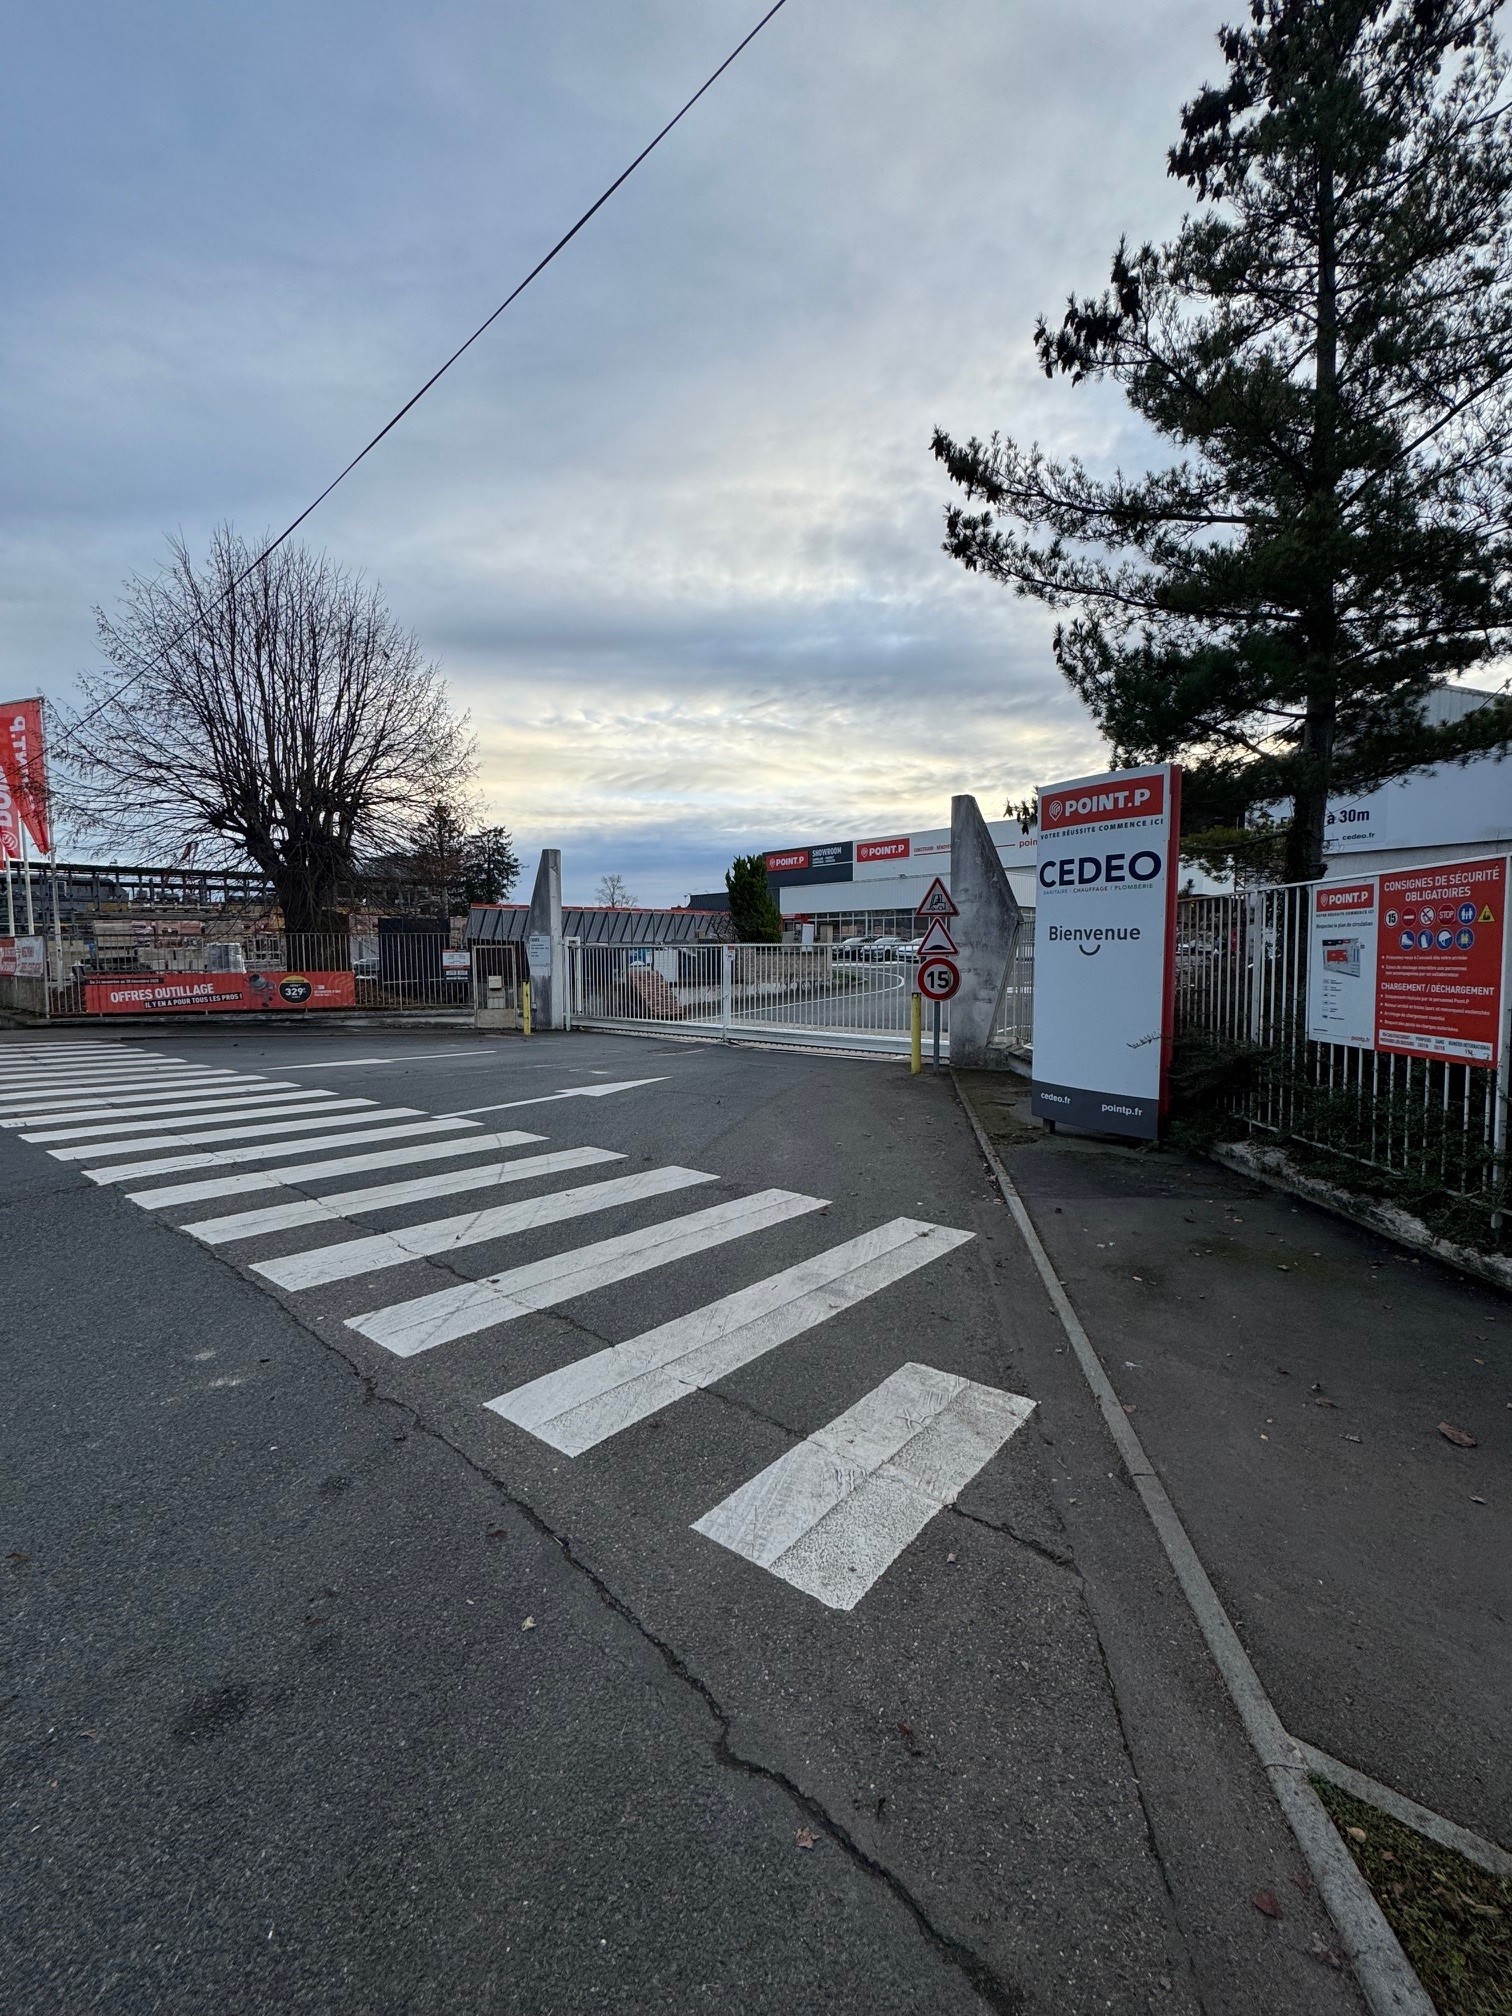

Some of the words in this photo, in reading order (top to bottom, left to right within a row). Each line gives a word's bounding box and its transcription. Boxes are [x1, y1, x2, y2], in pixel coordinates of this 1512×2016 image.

[1065, 788, 1151, 817] POINT.P
[1340, 809, 1370, 823] 30m
[1041, 832, 1060, 840] VOTRE
[1062, 827, 1096, 837] RÉUSSITE
[1098, 820, 1147, 832] COMMENCE
[1150, 818, 1164, 826] ICI
[1342, 832, 1376, 841] cedeo.fr
[812, 846, 842, 858] SHOWROOM
[869, 844, 905, 857] POINT.P
[776, 855, 805, 867] POINT.P
[1039, 850, 1162, 888] CEDEO
[1384, 876, 1433, 892] CONSIGNES
[1435, 875, 1448, 886] DE
[1449, 866, 1500, 885] SÉCURITÉ
[1073, 885, 1108, 893] CHAUFFAGE
[1114, 882, 1153, 891] PLOMBERIE
[1405, 886, 1471, 902] OBLIGATOIRES
[1328, 891, 1369, 906] POINT.P
[1387, 912, 1396, 924] 15
[1439, 910, 1455, 919] STOP
[1049, 925, 1141, 941] Bienvenue
[926, 970, 950, 989] 15
[110, 988, 153, 1003] OFFRES
[154, 983, 215, 999] OUTILLAGE
[1381, 982, 1426, 992] CHARGEMENT
[1431, 982, 1494, 996] DÉCHARGEMENT
[173, 998, 191, 1006] POUR
[192, 996, 209, 1004] TOUS
[221, 993, 239, 1001] PROS
[1040, 1091, 1071, 1105] cedeo.fr
[1102, 1103, 1143, 1117] pointp.fr
